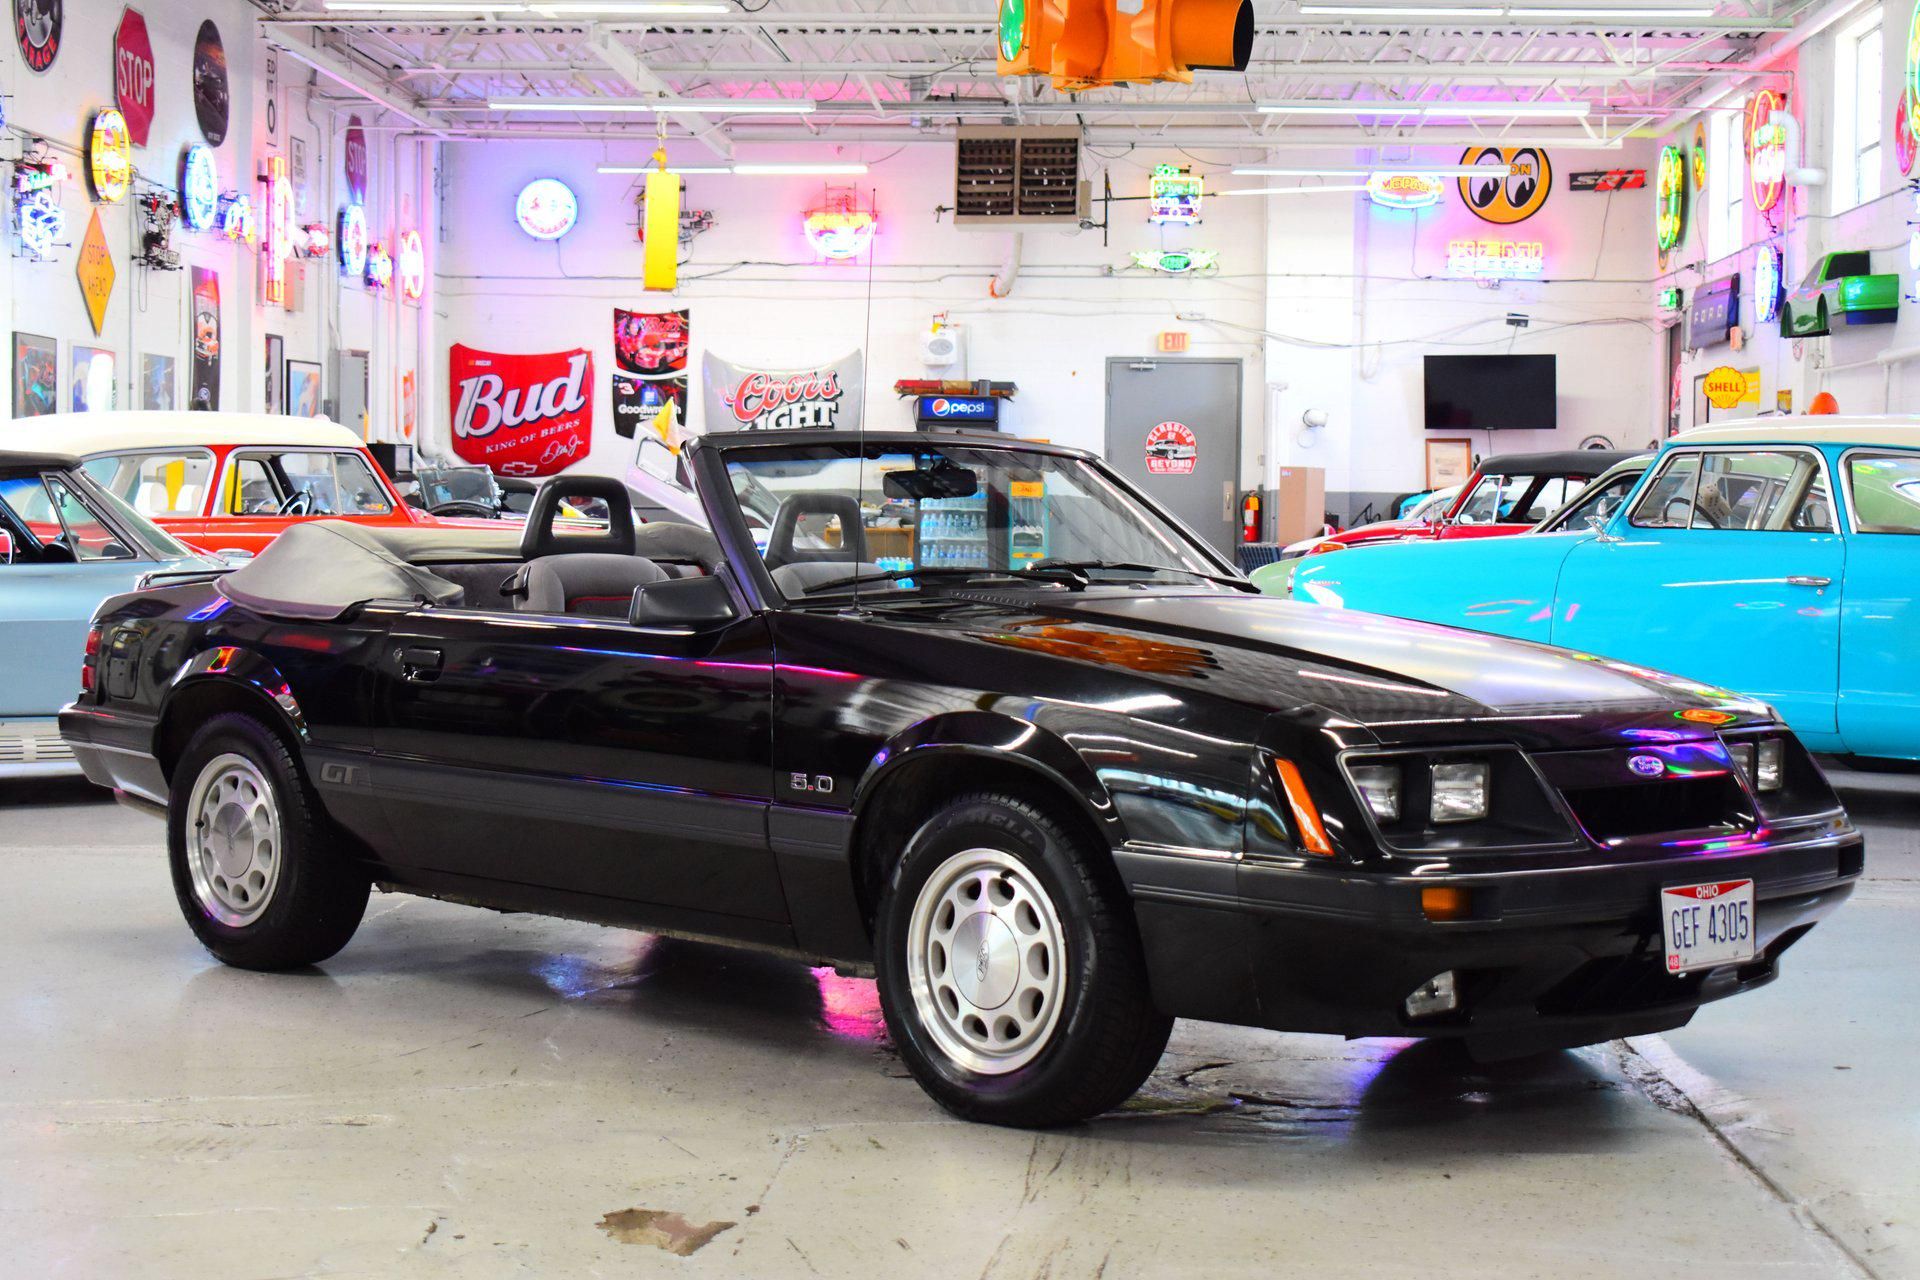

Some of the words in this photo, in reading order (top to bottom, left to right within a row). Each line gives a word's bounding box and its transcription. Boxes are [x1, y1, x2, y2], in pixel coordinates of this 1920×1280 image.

[118, 47, 153, 107] STOP
[1571, 173, 1643, 187] SRT
[1694, 304, 1723, 323] FORD
[1164, 332, 1187, 350] EXIT
[454, 353, 588, 439] Bud
[724, 371, 844, 422] Coors
[1708, 382, 1740, 393] SHELL
[950, 402, 985, 415] pepsi
[486, 440, 516, 454] KING
[520, 433, 537, 444] OF
[540, 418, 580, 438] BEERS
[1148, 422, 1194, 443] CLASSICS
[1150, 459, 1192, 469] BEYOND
[321, 762, 360, 785] GT
[790, 772, 833, 793] 5.0
[1696, 884, 1719, 899] OHIO
[1671, 906, 1701, 950] GEF
[1708, 900, 1749, 944] 4305
